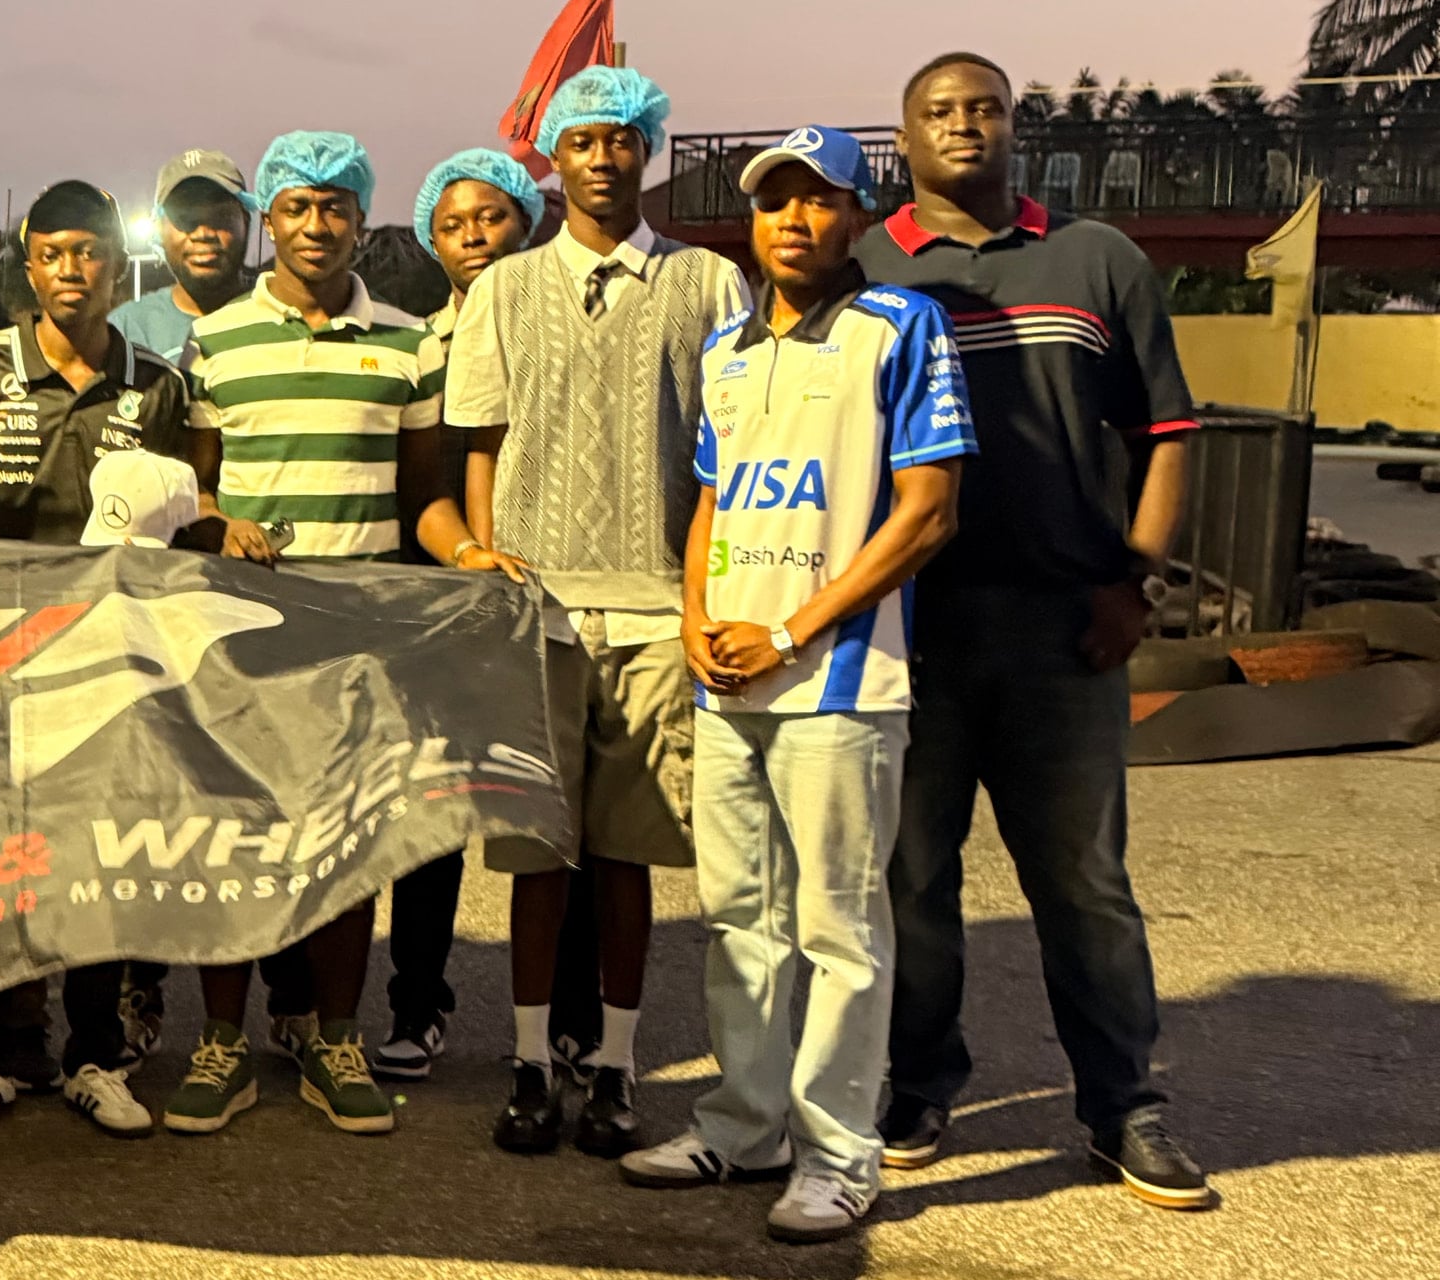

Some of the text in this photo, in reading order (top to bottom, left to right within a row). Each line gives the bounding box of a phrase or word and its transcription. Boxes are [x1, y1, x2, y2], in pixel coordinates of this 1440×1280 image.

[7, 414, 38, 431] UBS
[717, 459, 827, 511] VISA
[732, 545, 827, 573] Cash App
[93, 738, 555, 869] WHEELS
[69, 793, 409, 905] MOTORSPORTS
